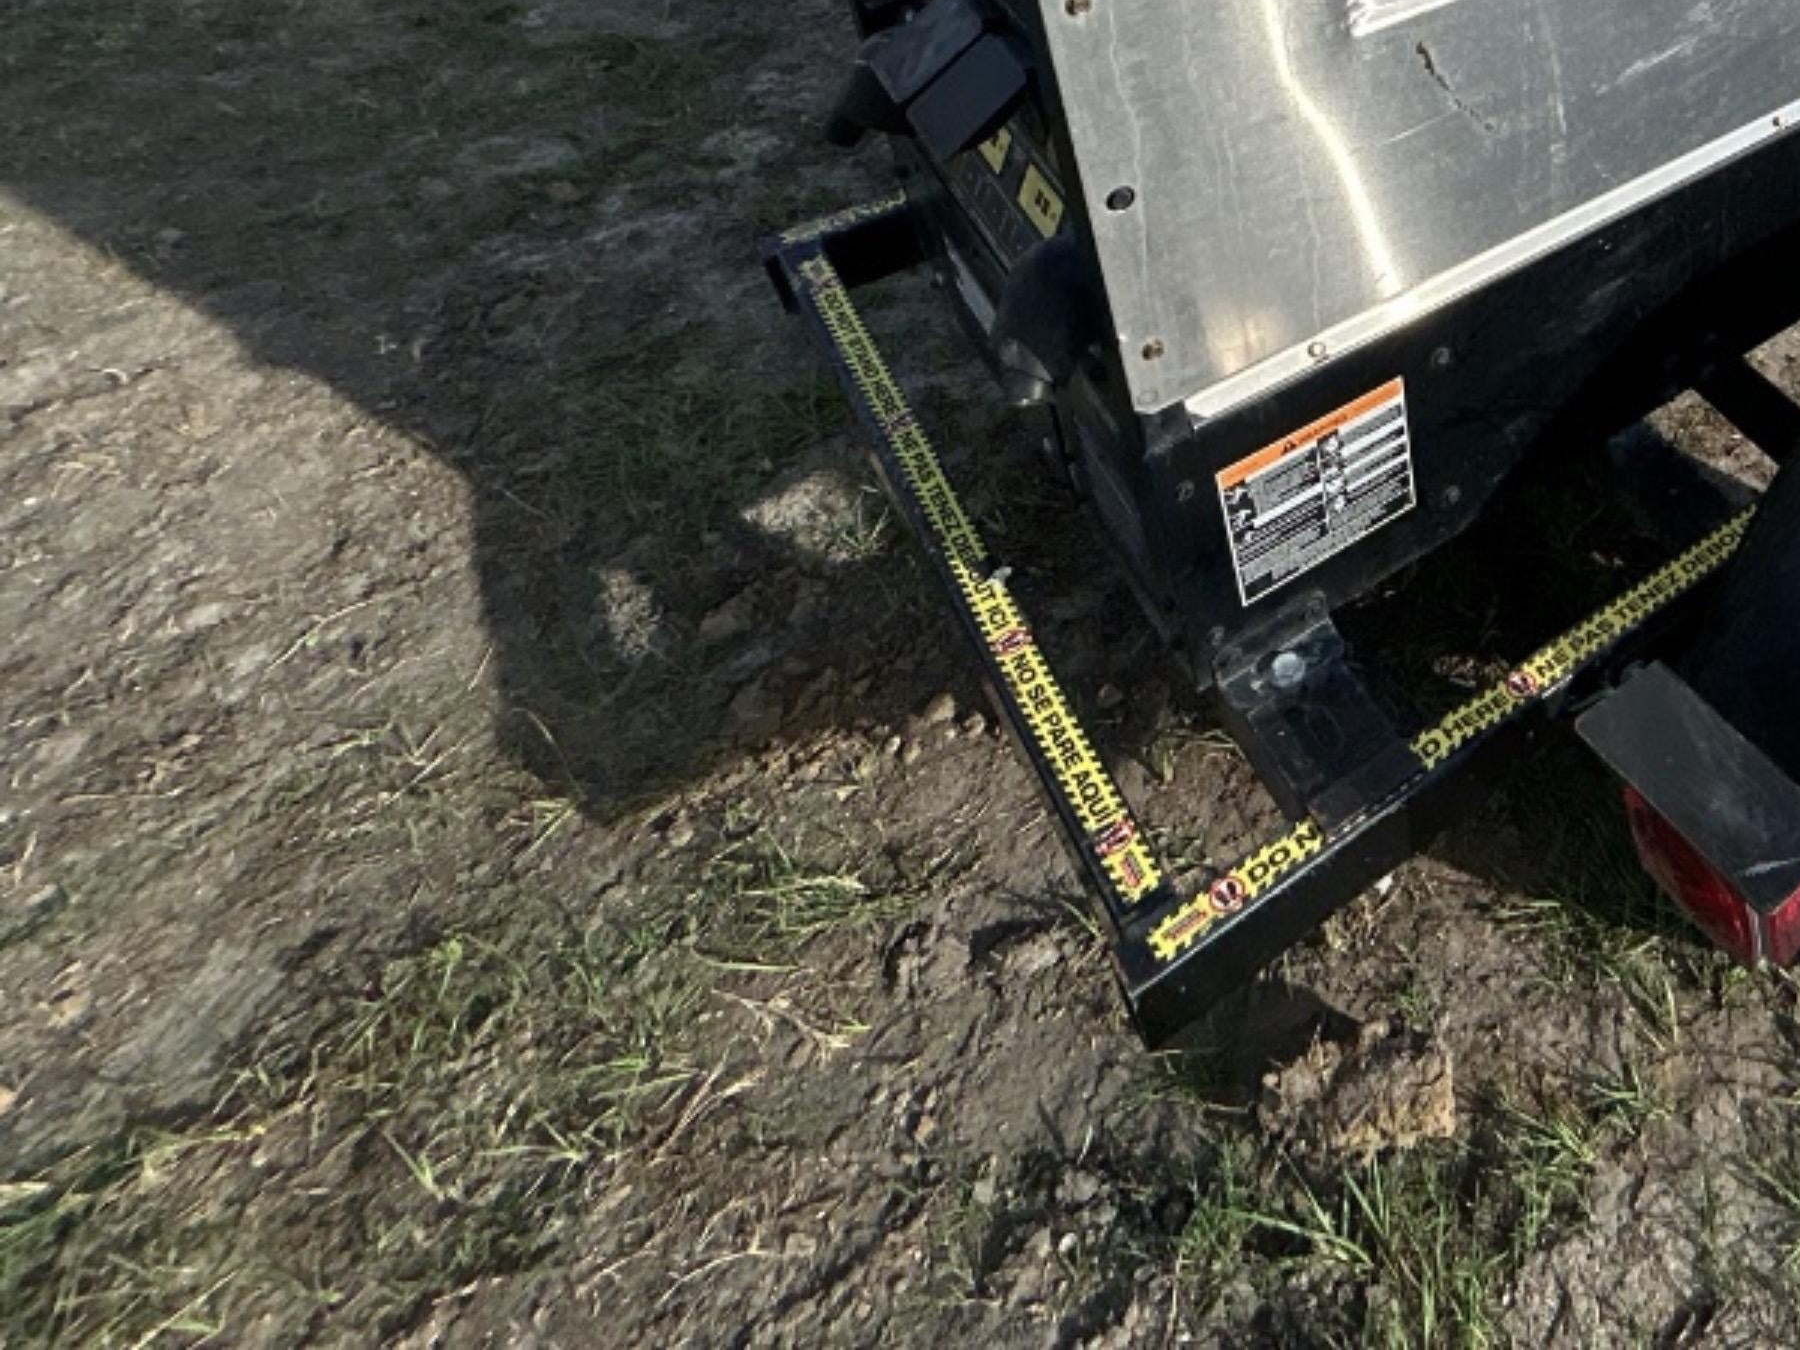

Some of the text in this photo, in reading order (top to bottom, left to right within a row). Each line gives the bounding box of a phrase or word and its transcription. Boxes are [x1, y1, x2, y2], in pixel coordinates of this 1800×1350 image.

[1010, 652, 1037, 685] NO
[1026, 684, 1052, 713] SE
[1041, 713, 1084, 771] PARE
